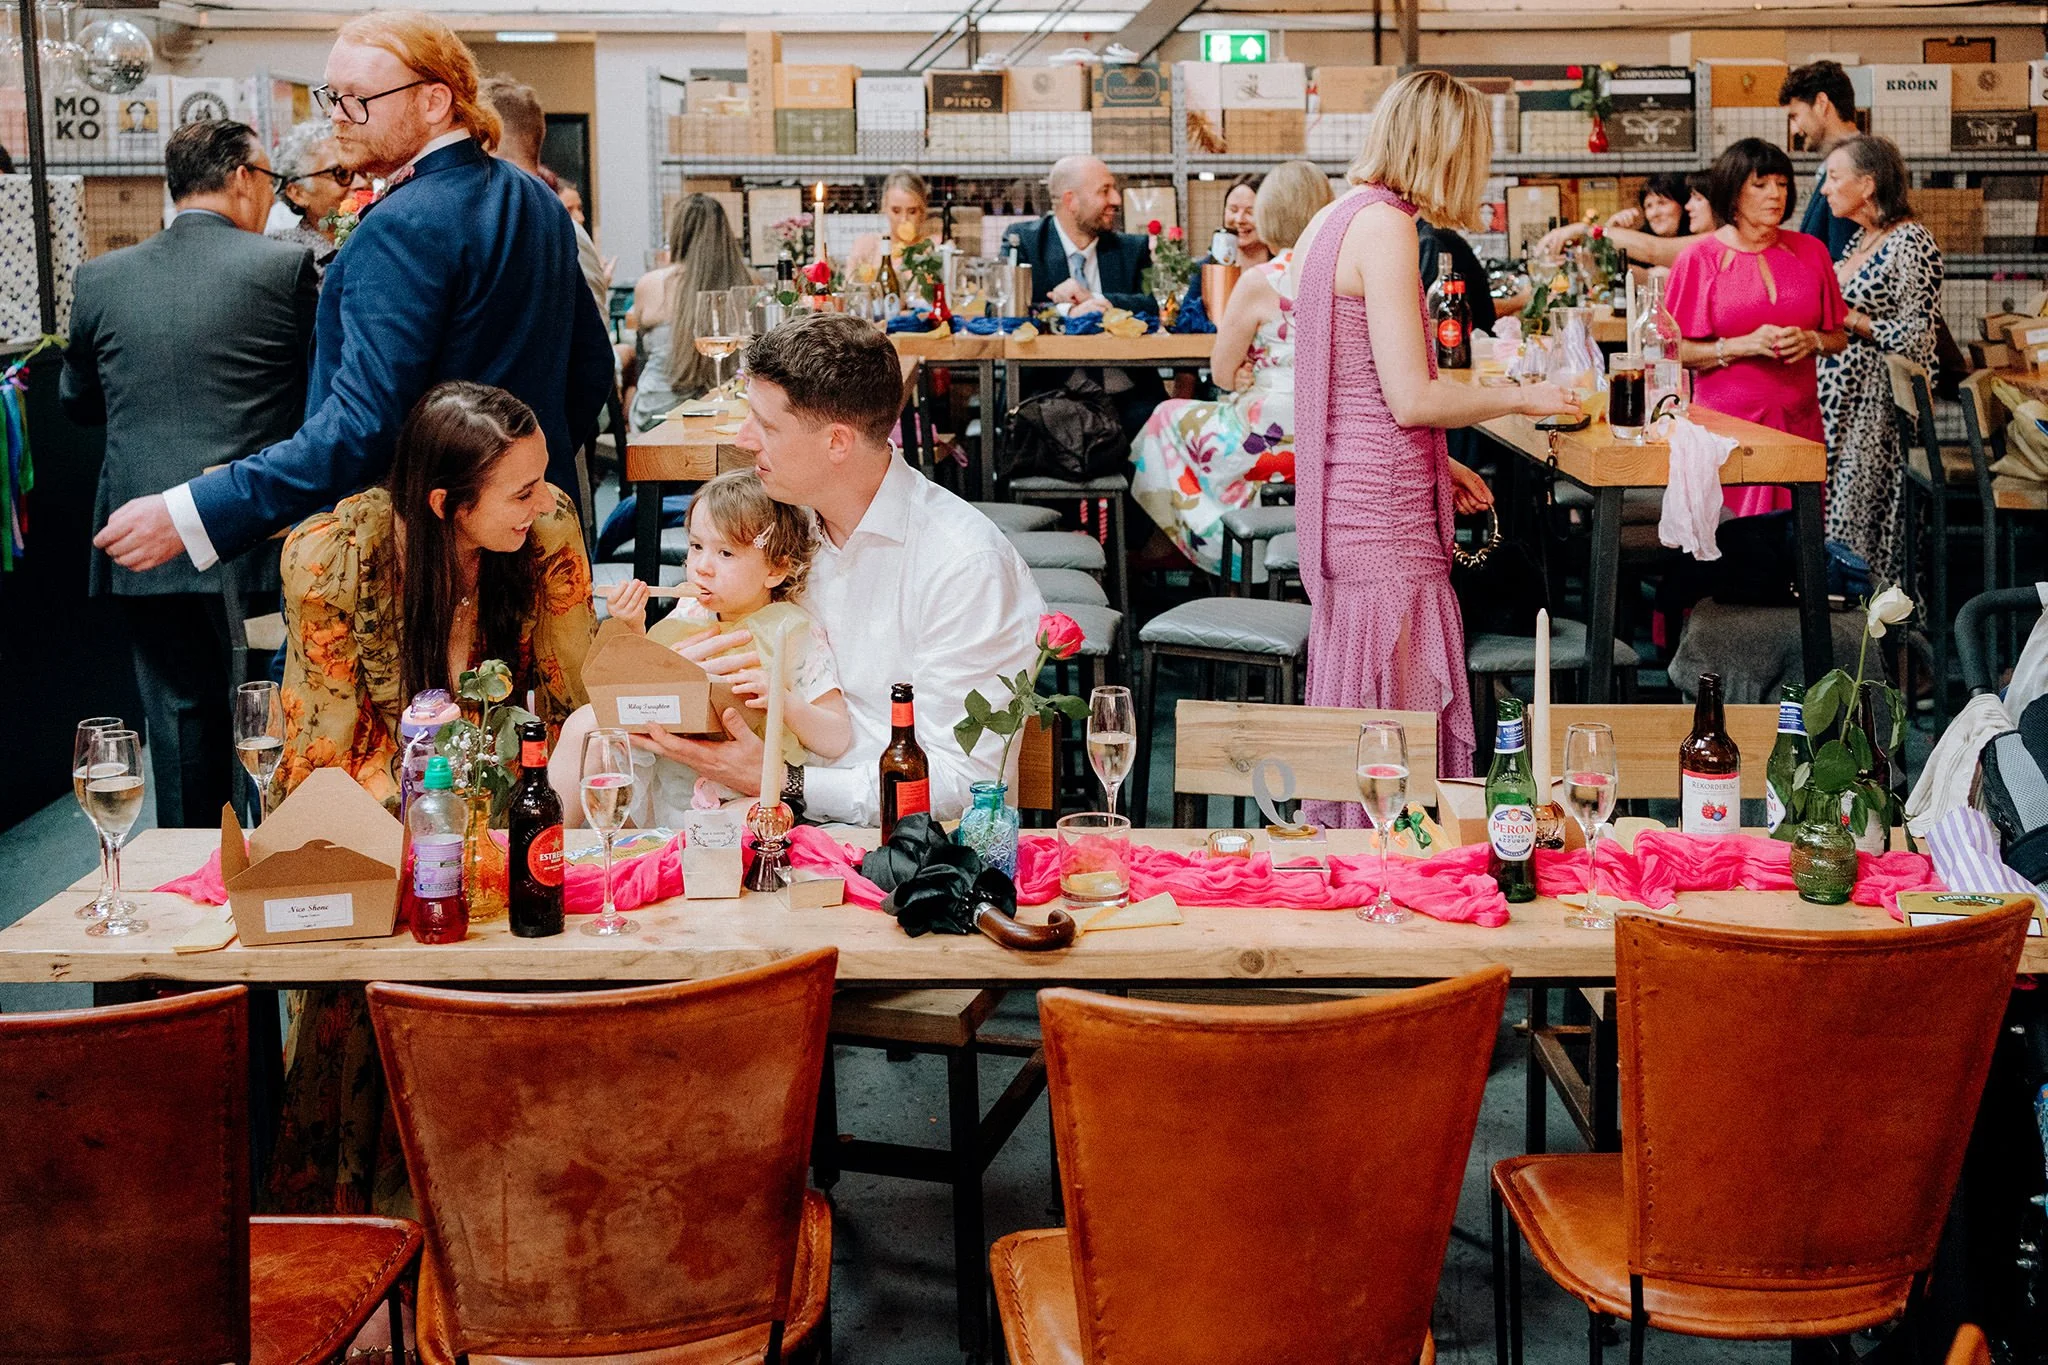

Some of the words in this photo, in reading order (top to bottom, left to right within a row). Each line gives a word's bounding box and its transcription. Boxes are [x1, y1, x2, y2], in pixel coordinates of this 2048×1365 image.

[1886, 79, 1938, 91] KROHN
[55, 96, 100, 116] MO
[943, 96, 993, 108] PINTO
[56, 120, 100, 140] KO
[1691, 780, 1736, 791] REKORDERLIG
[1493, 821, 1534, 835] PERONI
[1936, 894, 1972, 902] AMBER
[1975, 896, 2002, 904] LEAF
